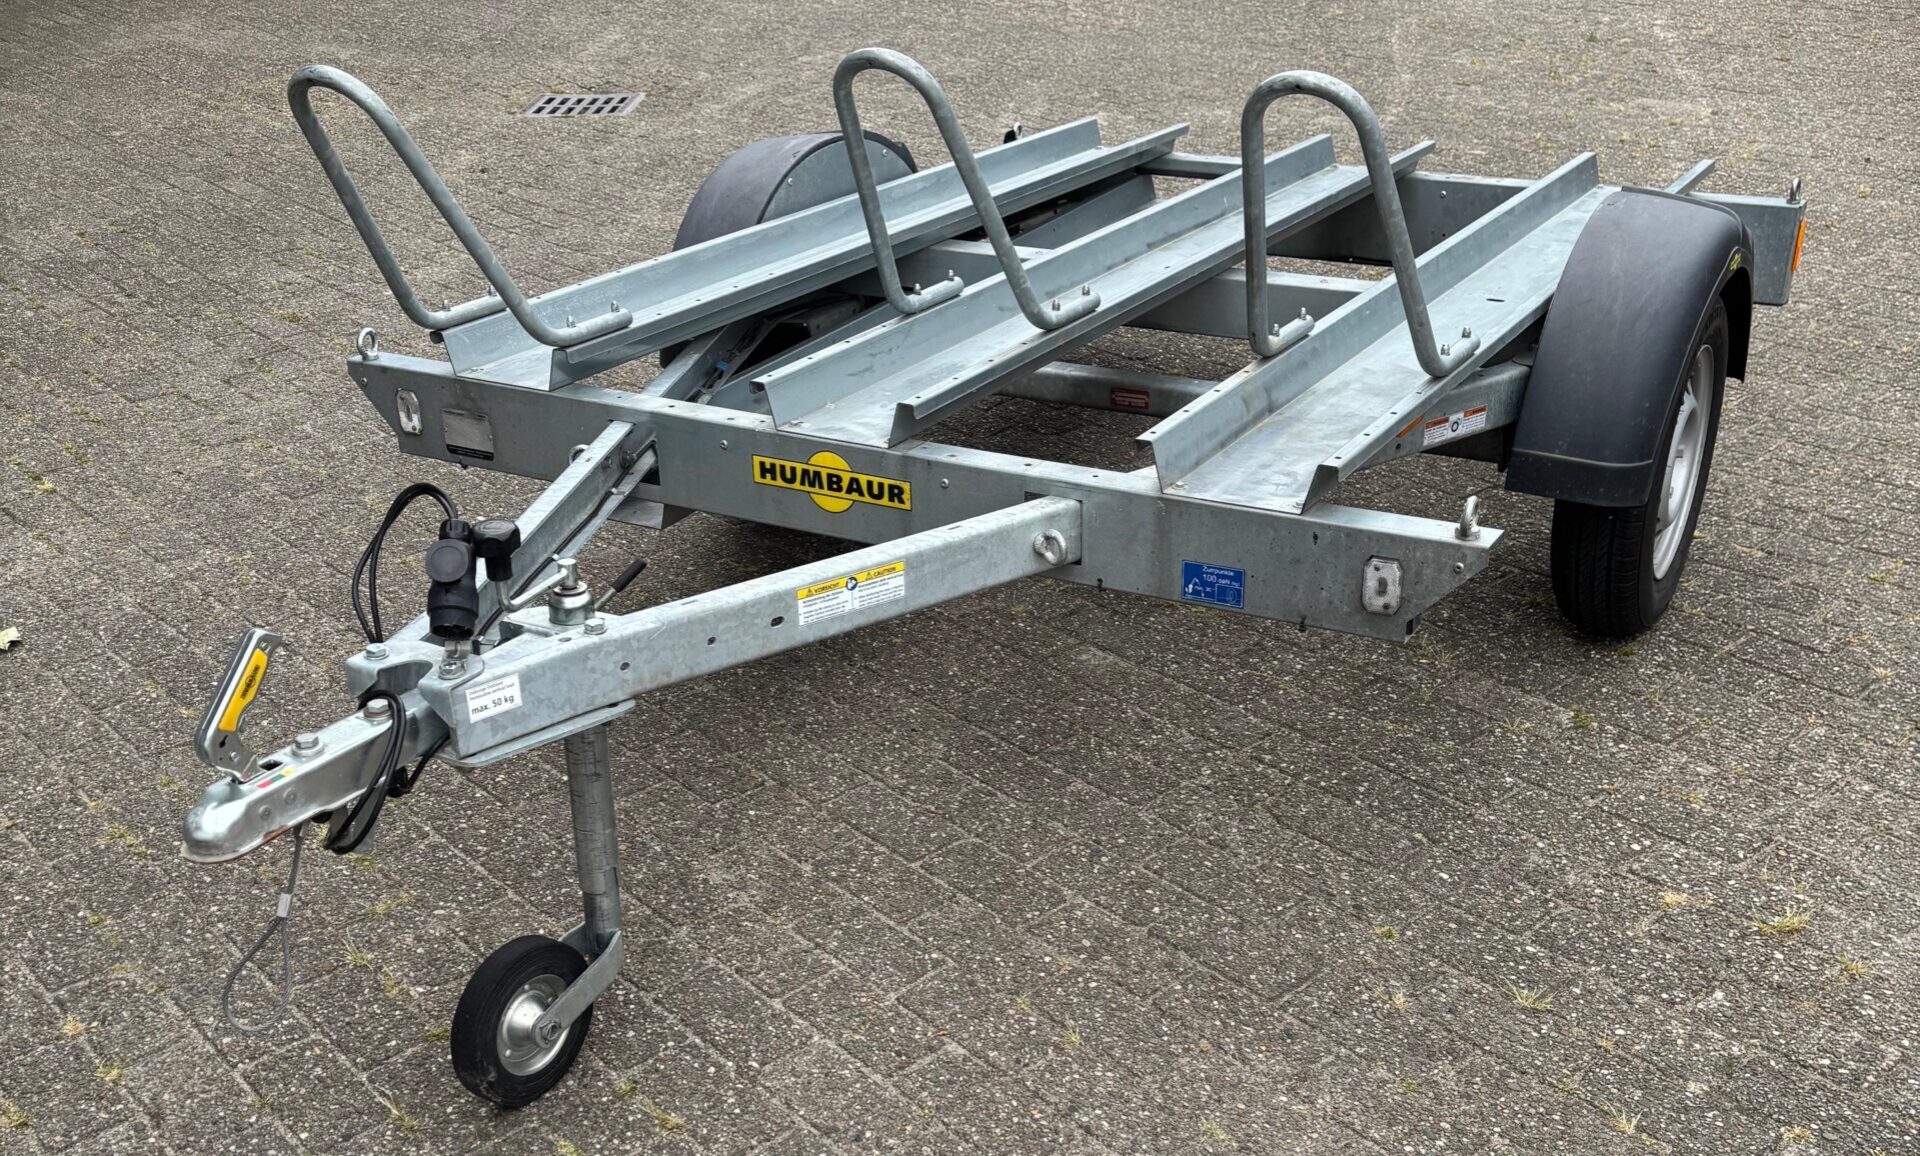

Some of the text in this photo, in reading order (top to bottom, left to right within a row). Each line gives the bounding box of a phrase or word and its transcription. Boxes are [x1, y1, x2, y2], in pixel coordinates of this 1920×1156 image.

[759, 461, 905, 504] HUMBAUR
[873, 567, 896, 576] CAUTION
[1202, 574, 1217, 583] 100
[472, 705, 491, 715] max.
[492, 698, 502, 707] 50
